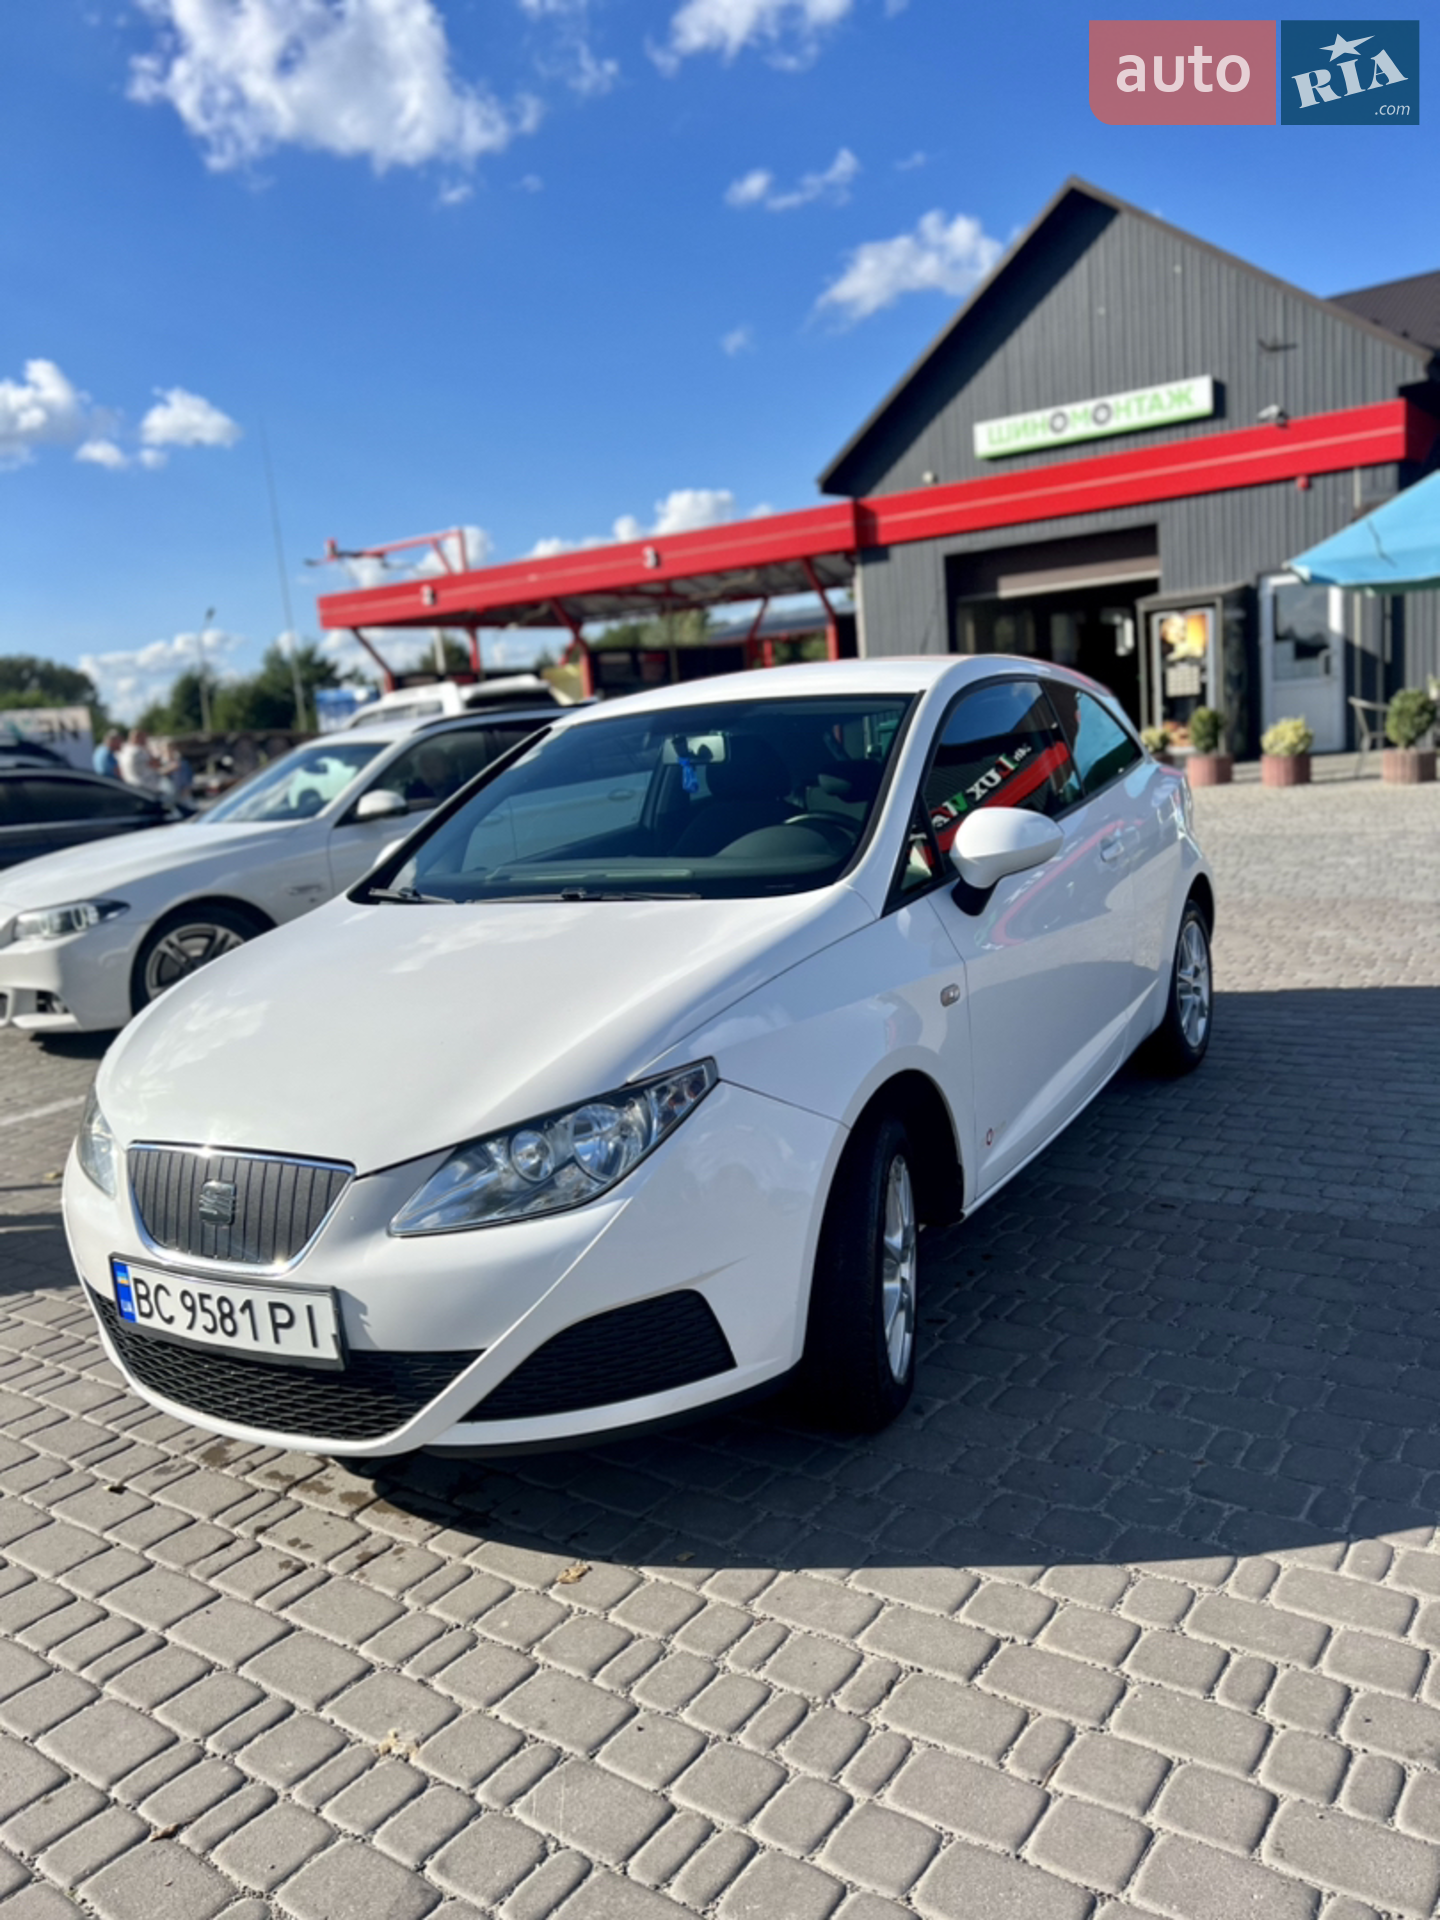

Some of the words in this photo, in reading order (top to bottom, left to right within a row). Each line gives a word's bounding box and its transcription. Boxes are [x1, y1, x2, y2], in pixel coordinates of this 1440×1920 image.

[987, 385, 1195, 445] ШИНОМОНТАЖ
[132, 1277, 175, 1325] BC
[179, 1289, 259, 1342] 9581
[268, 1301, 319, 1349] PI
